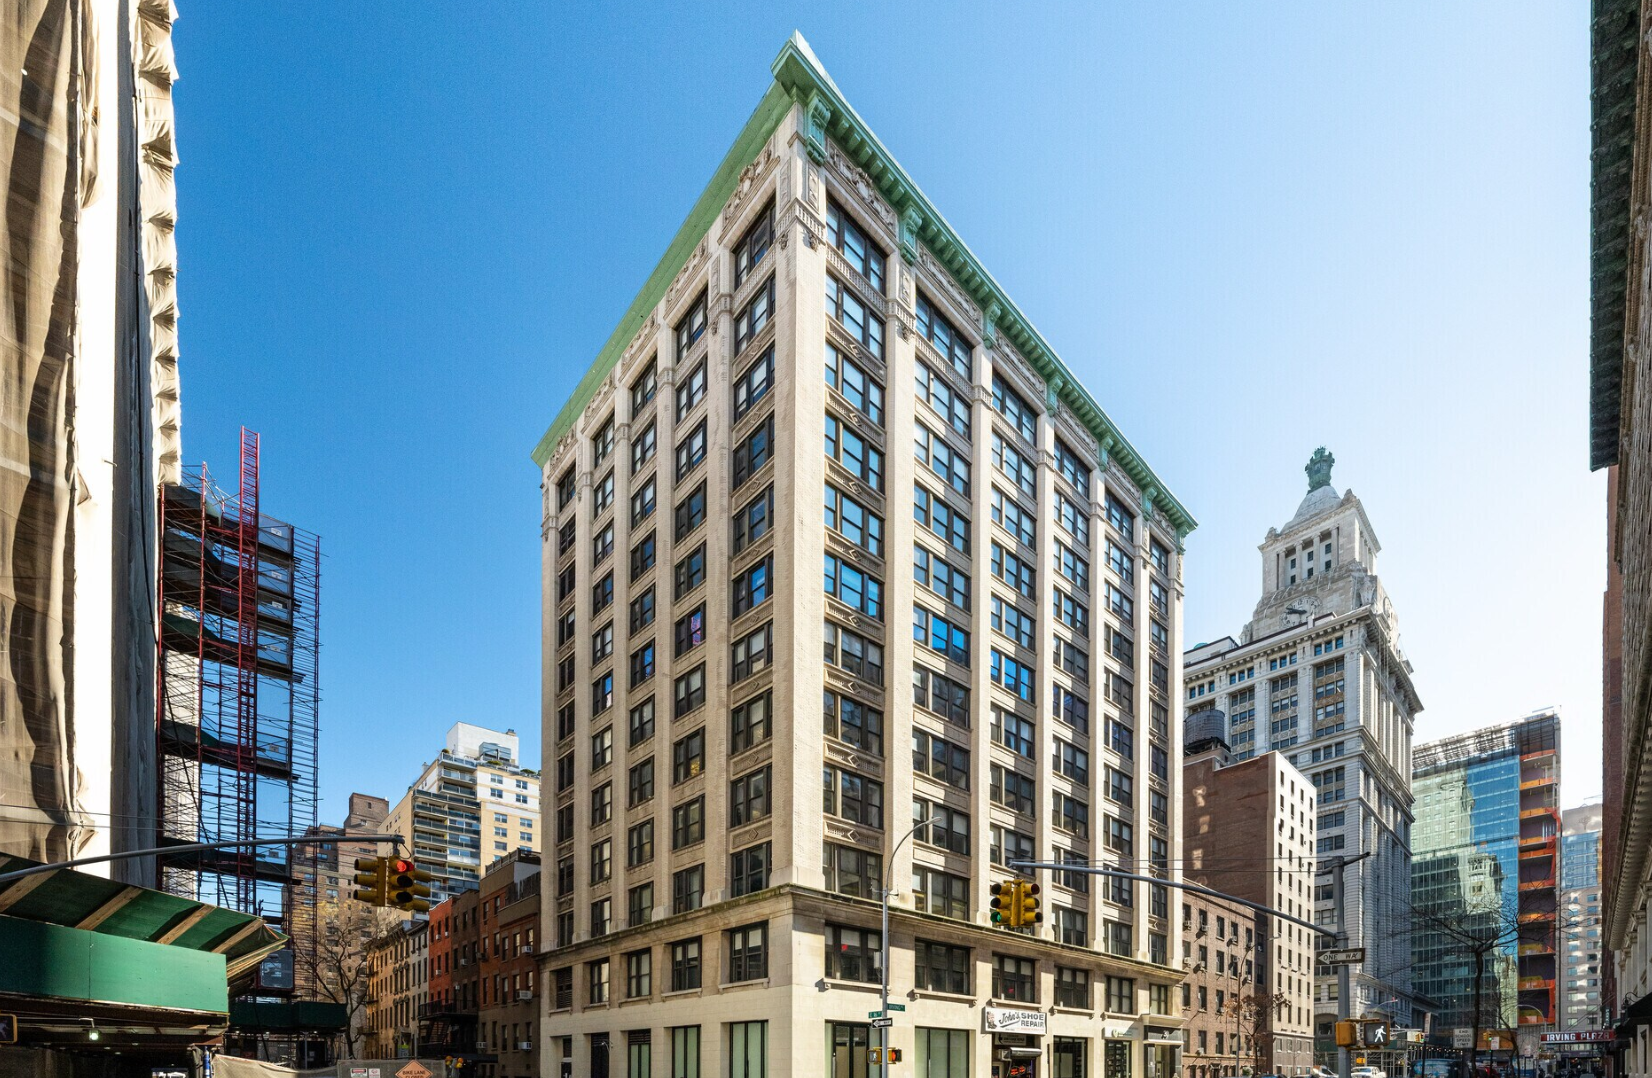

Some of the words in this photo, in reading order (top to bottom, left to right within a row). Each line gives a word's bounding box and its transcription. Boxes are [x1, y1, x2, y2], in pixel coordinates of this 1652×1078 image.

[1345, 952, 1358, 960] WAY
[999, 1012, 1020, 1024] John's
[1021, 1012, 1044, 1021] SHOE
[1021, 1020, 1044, 1028] REPAIR
[1547, 1033, 1576, 1042] IRVING
[1580, 1032, 1610, 1040] PLAZA
